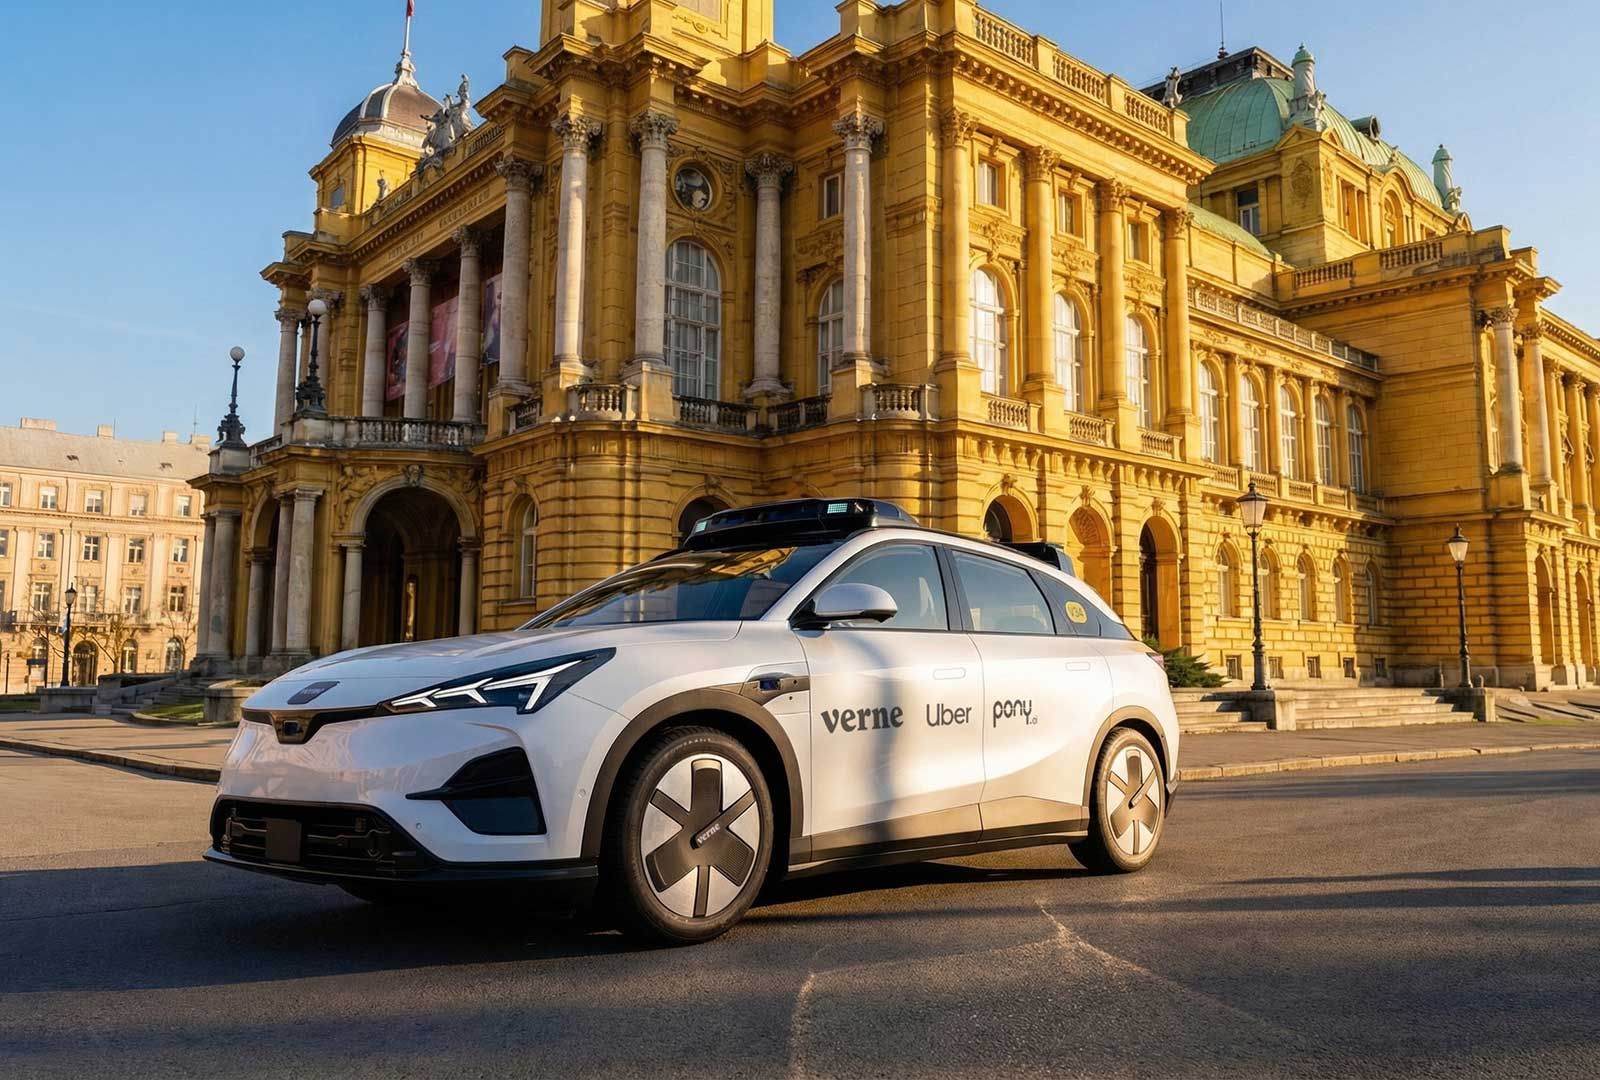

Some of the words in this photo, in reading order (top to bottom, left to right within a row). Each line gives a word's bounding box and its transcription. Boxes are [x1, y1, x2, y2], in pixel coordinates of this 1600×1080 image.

[820, 706, 904, 734] verne
[926, 703, 972, 727] Uber
[697, 823, 720, 844] verne
